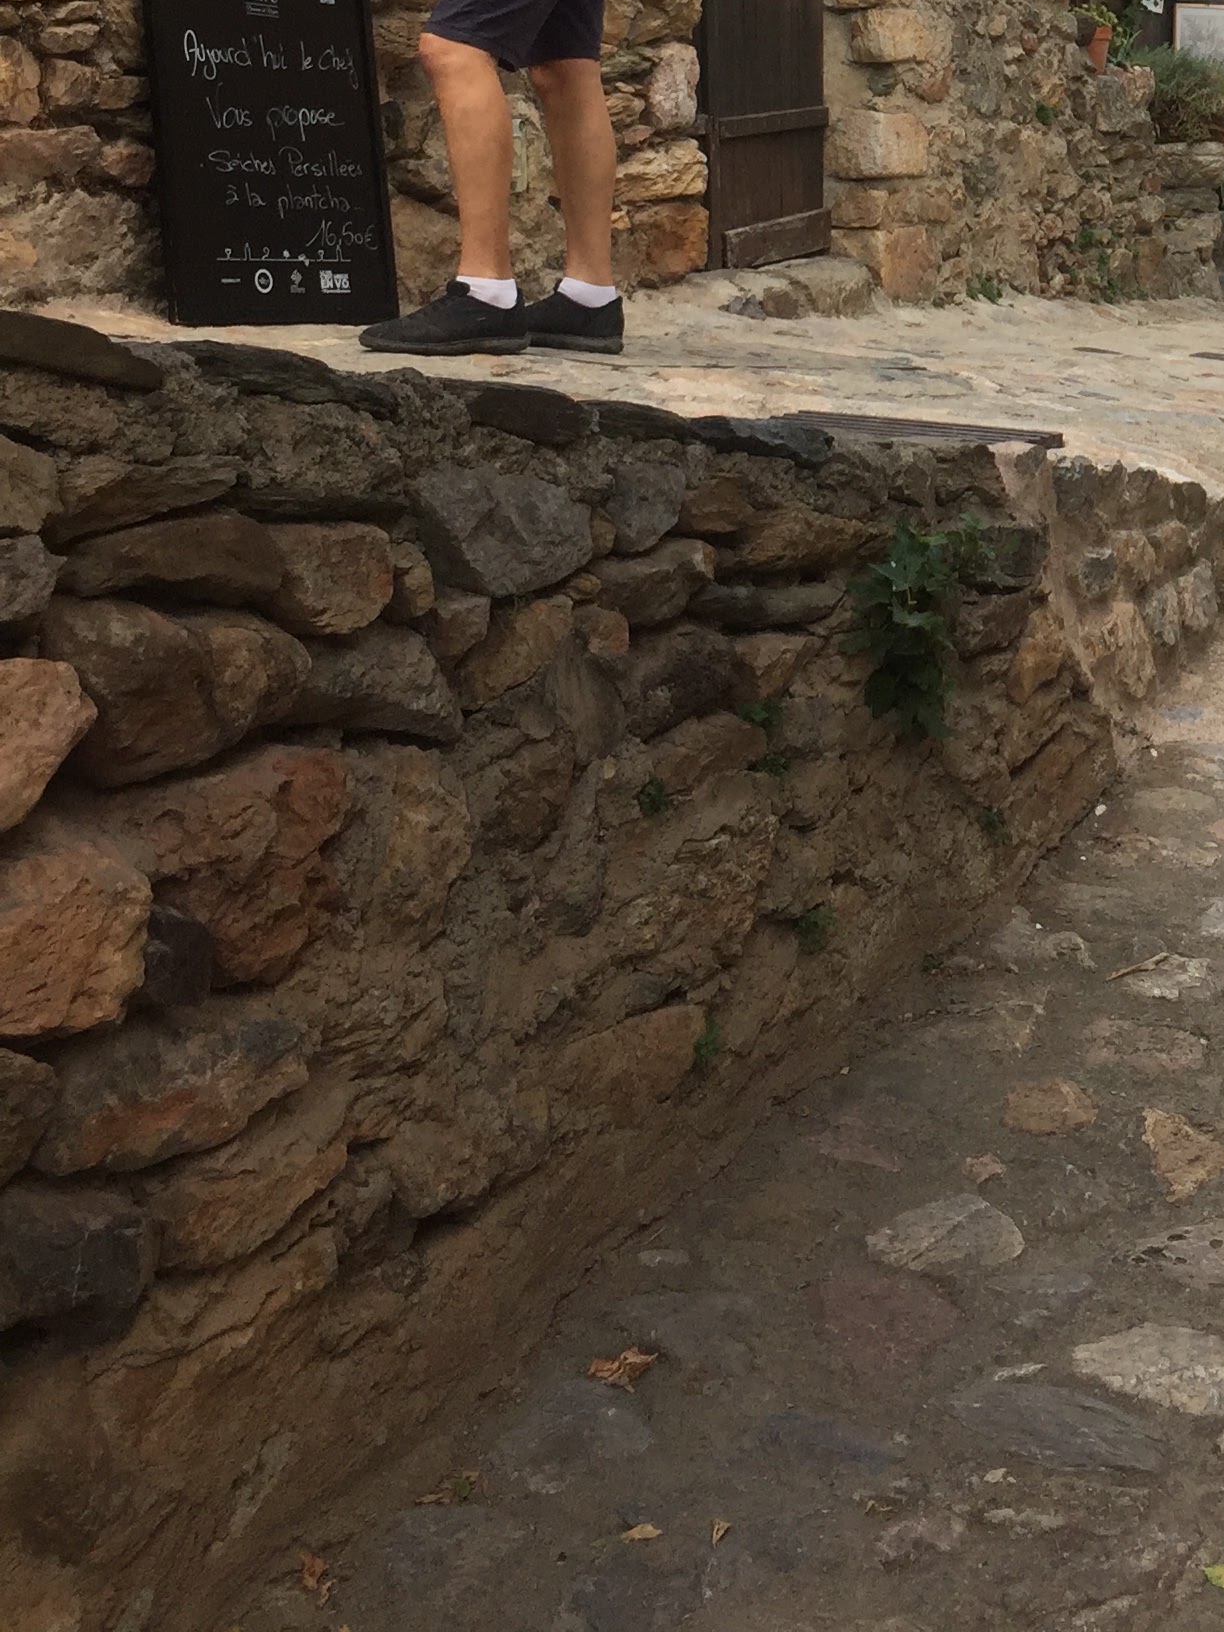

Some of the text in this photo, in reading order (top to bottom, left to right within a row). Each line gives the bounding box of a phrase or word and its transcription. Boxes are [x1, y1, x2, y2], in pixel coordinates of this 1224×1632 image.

[300, 41, 313, 70] le
[267, 105, 345, 142] propose
[245, 182, 267, 207] la
